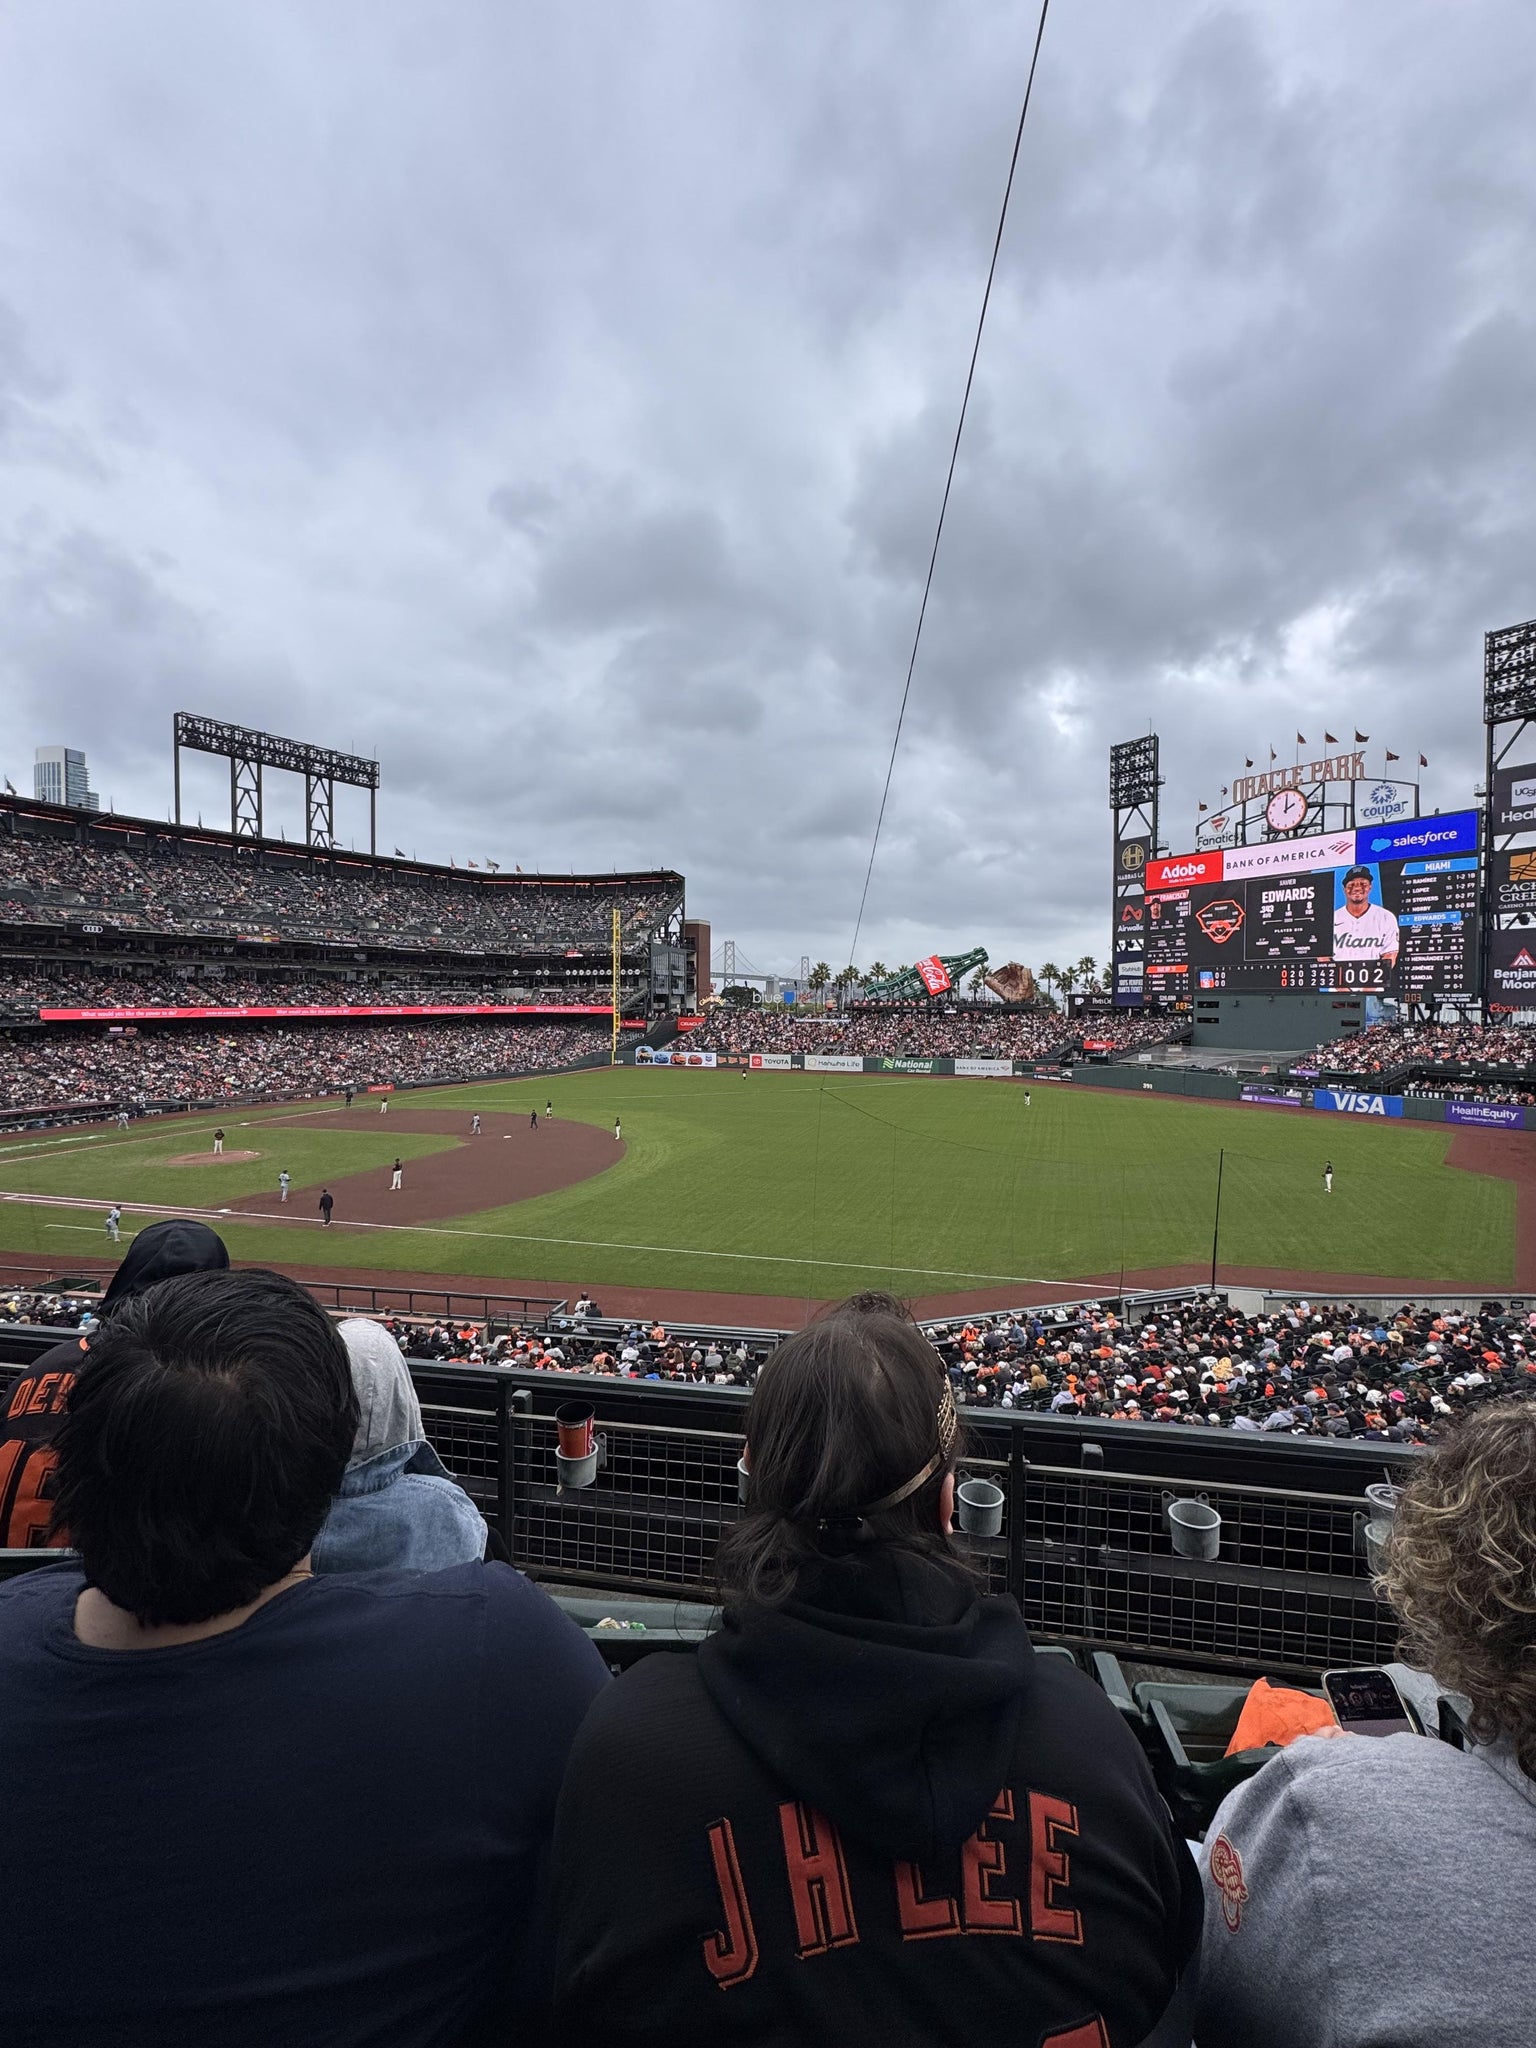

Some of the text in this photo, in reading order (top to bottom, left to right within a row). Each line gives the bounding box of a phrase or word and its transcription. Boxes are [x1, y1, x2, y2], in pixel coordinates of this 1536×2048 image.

[1232, 751, 1366, 804] ORACLE PARK
[1362, 802, 1401, 818] coupa
[1393, 830, 1458, 847] salesforce
[1226, 849, 1325, 870] BANK OF AMERICA
[1425, 862, 1450, 872] MIAMI
[1161, 862, 1206, 880] Adobe
[1262, 886, 1315, 904] EDWARDS
[1498, 902, 1524, 910] CASINO
[1414, 914, 1446, 922] EDWARDS
[1334, 932, 1384, 948] Miami
[1281, 970, 1288, 978] 0
[1290, 970, 1296, 978] 2
[1298, 970, 1304, 978] 0
[1310, 970, 1316, 978] 3
[1346, 969, 1354, 983] 0
[1359, 968, 1368, 983] 0
[1373, 968, 1384, 982] 2
[1298, 978, 1304, 986] 0
[1310, 978, 1316, 986] 2
[1320, 978, 1326, 986] 3
[1329, 978, 1334, 986] 2
[752, 991, 783, 1004] blue
[894, 1060, 933, 1069] National
[1404, 1090, 1444, 1100] WELCOME
[1330, 1092, 1386, 1116] VISA
[1452, 1105, 1517, 1120] HealthEquity
